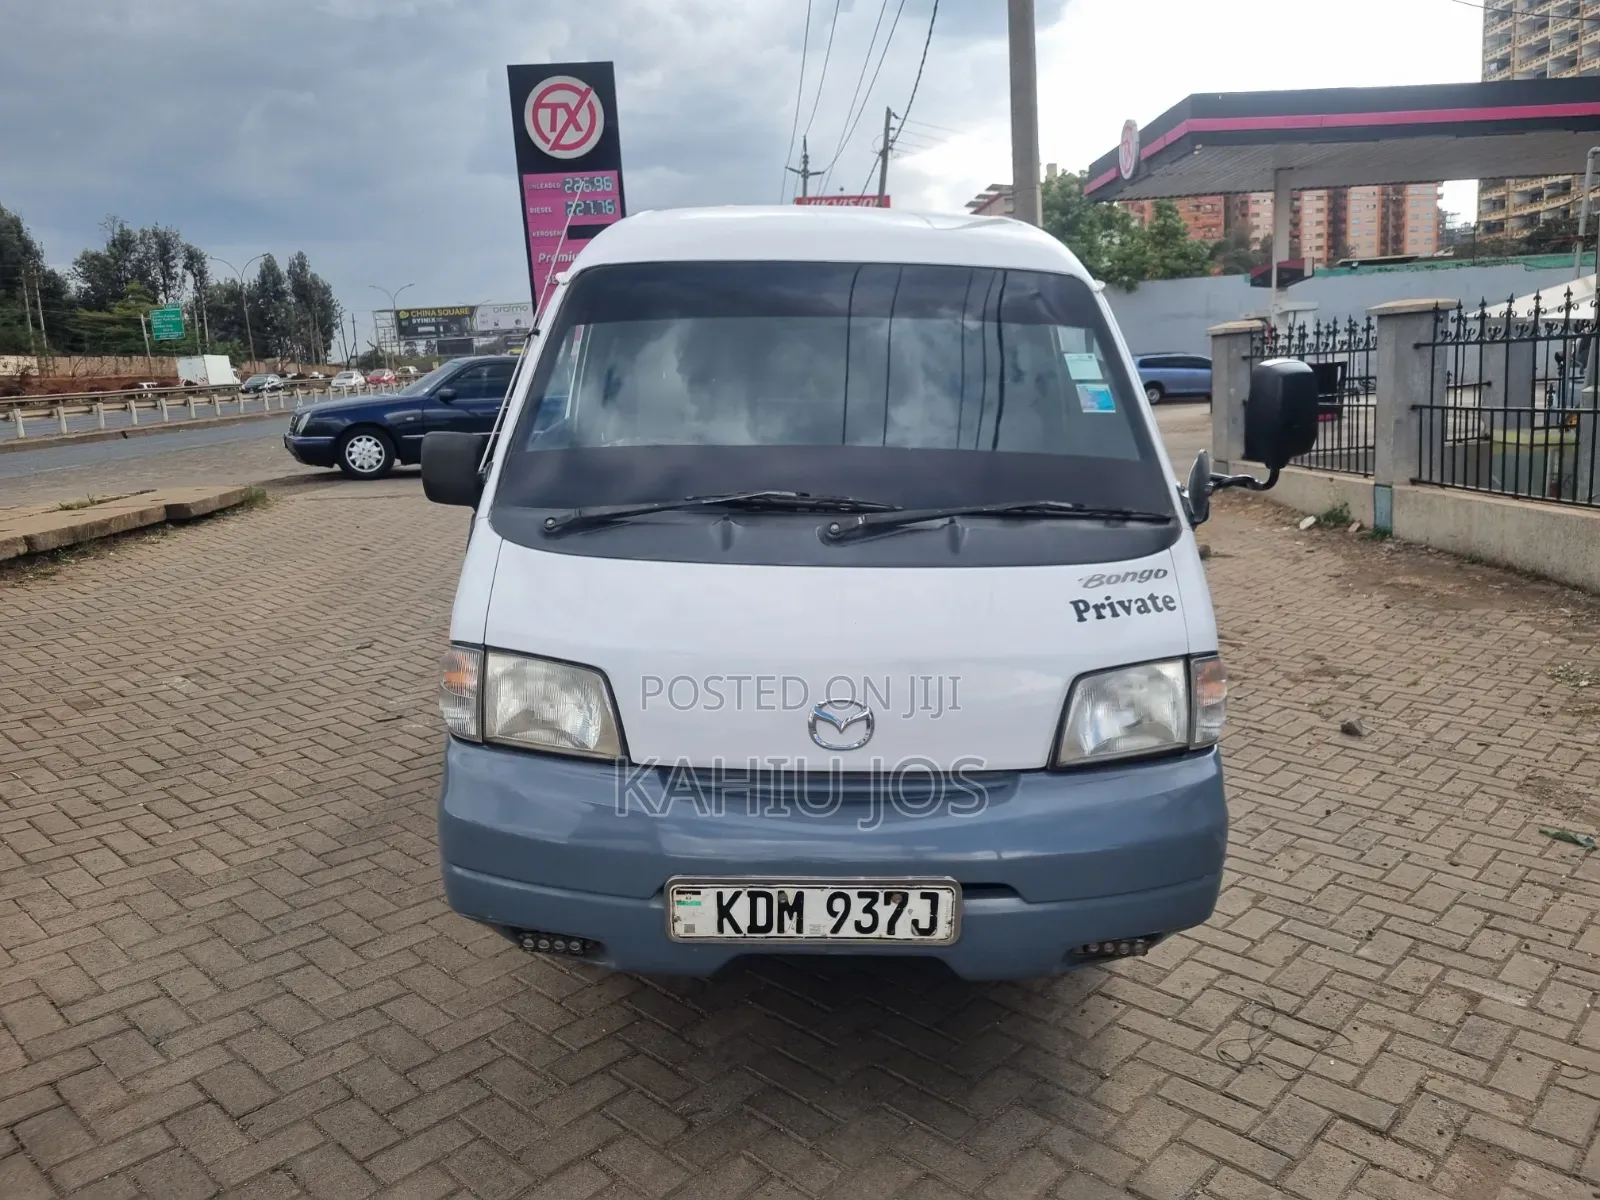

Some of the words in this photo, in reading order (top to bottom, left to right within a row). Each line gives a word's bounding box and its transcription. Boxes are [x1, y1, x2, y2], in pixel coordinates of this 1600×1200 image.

[564, 176, 613, 193] 226.96
[530, 206, 552, 214] DIESEL
[411, 309, 437, 317] CHINA
[438, 307, 471, 316] SQUARE
[1082, 568, 1168, 589] Bongo
[1069, 592, 1177, 623] Private
[716, 890, 804, 935] KDM
[826, 890, 940, 937] 937J
